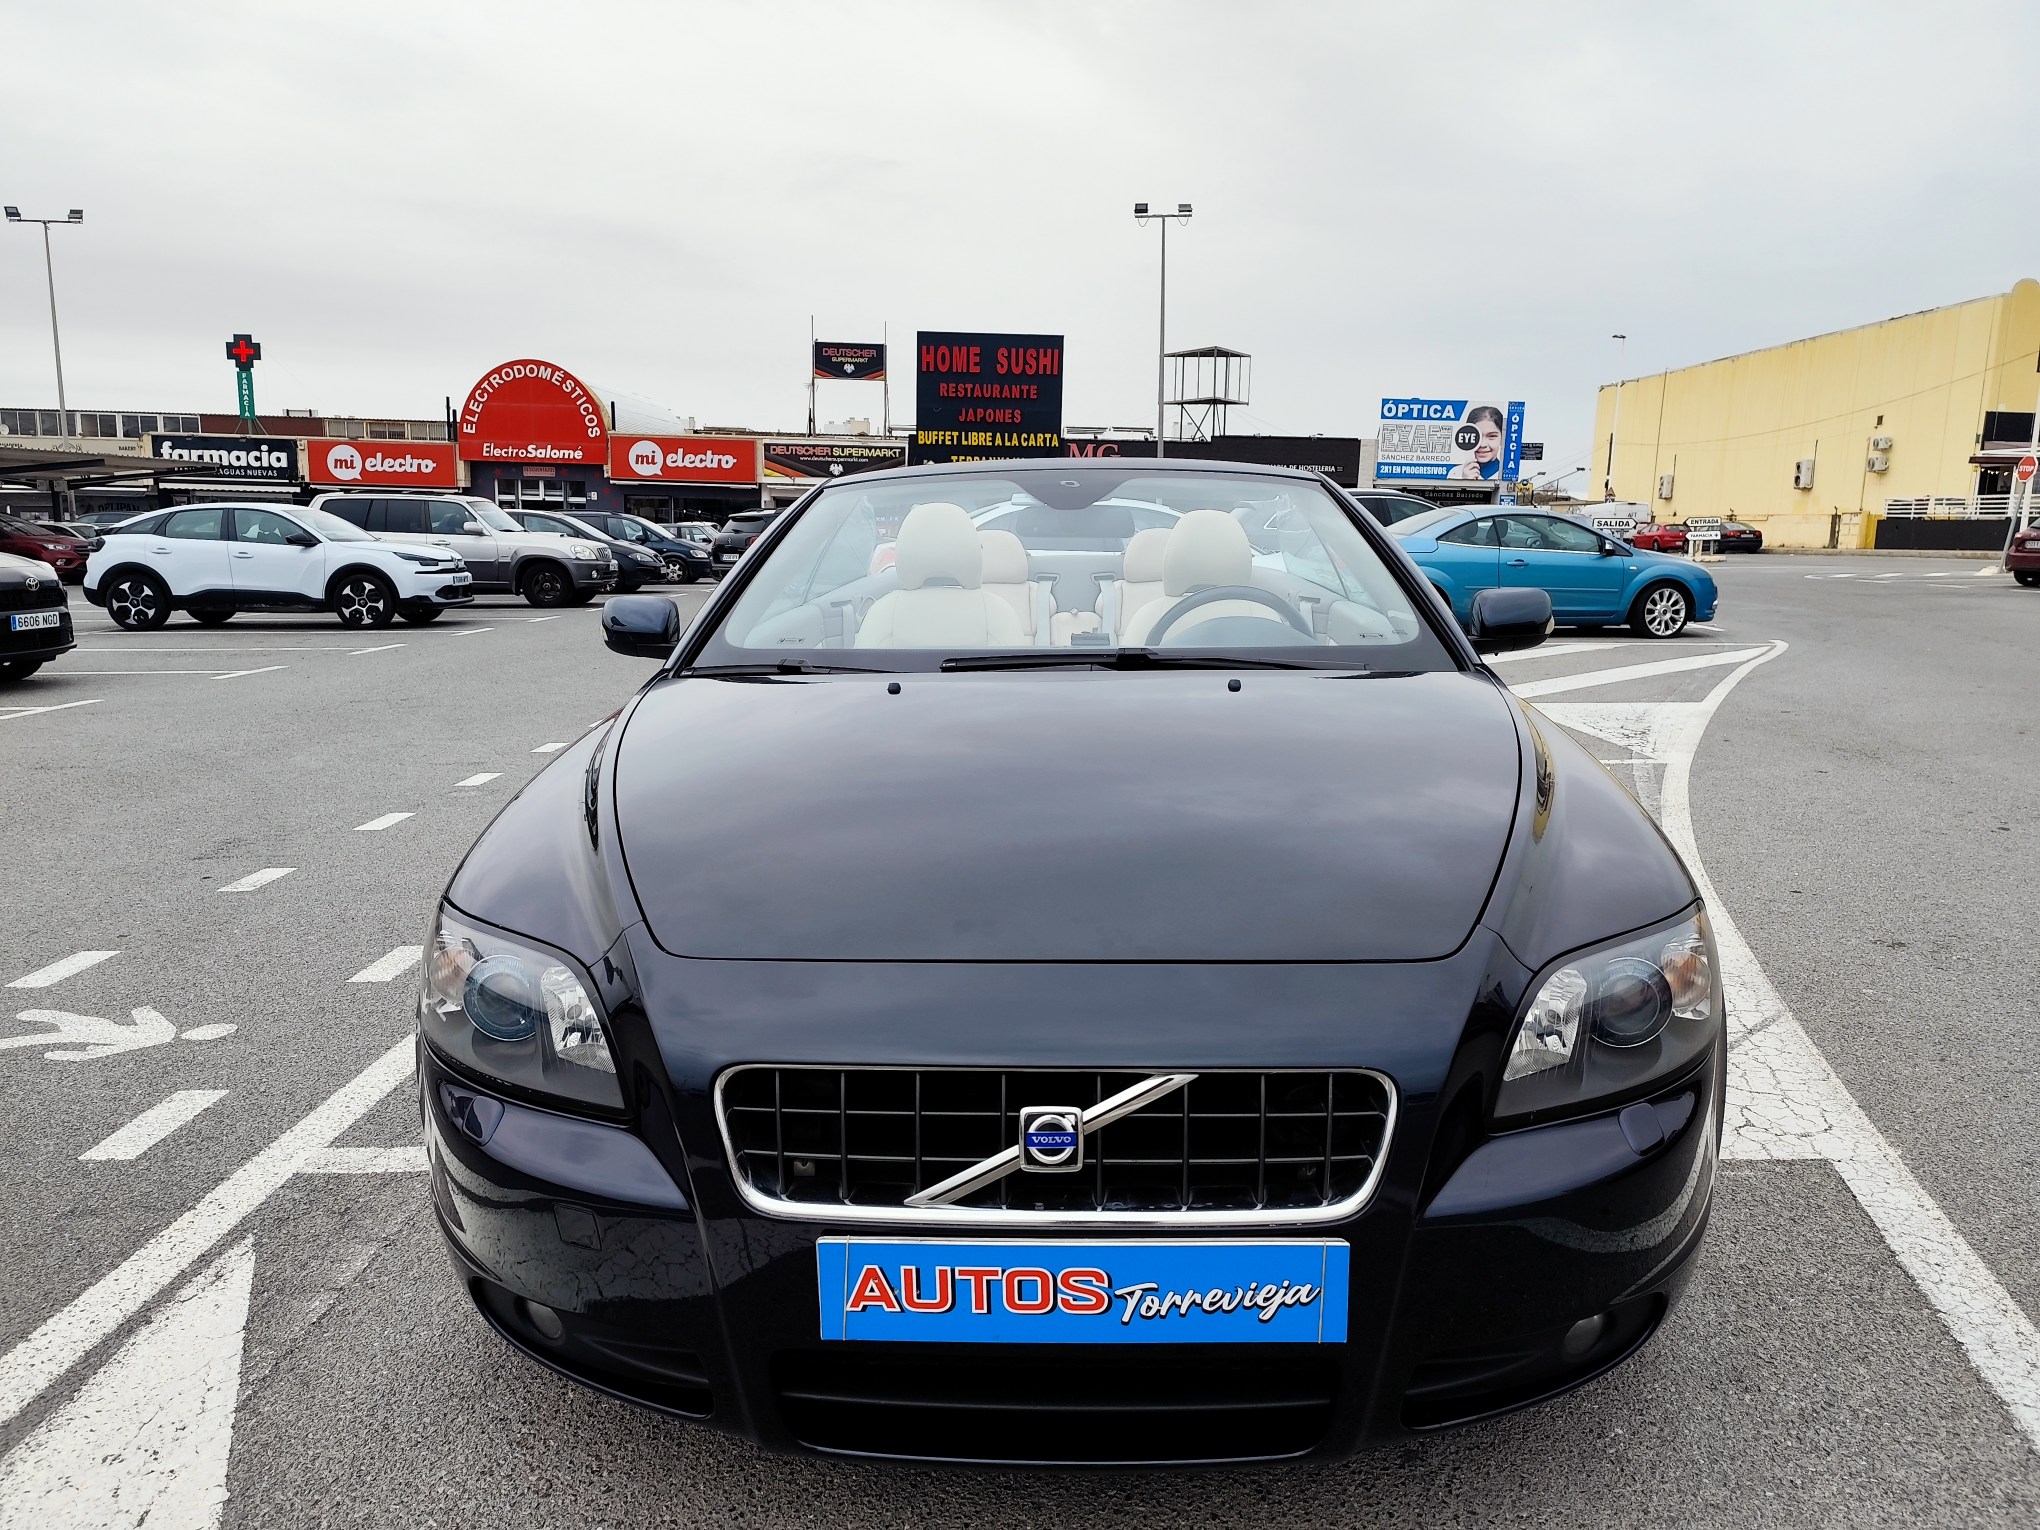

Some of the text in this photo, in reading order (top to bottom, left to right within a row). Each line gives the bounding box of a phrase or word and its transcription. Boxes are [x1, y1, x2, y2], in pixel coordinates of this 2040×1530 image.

[822, 347, 877, 357] DEUTSCHER
[921, 345, 1059, 375] HOME SUSHI
[241, 372, 250, 417] FARMACIA
[940, 383, 1038, 399] RESTAURANTE
[463, 364, 600, 438] ELECTRODOMÉSTICOS
[958, 408, 1022, 423] JAPONES
[1383, 400, 1455, 419] ÓPTICA
[918, 430, 1059, 447] BUFFET LIBRE A LA CARTA
[1458, 433, 1476, 443] EYE
[160, 440, 288, 468] farmacia
[482, 442, 584, 459] ElectroSalomé
[770, 445, 902, 457] DEUTSCHER SUPERMARKT
[1067, 443, 1121, 458] MG
[1381, 453, 1414, 461] SÁNCHEZ
[334, 452, 436, 473] mi electro
[635, 448, 737, 469] mi electro
[218, 468, 278, 477] AGUAS NUEVAS
[1380, 465, 1392, 473] 2X1
[1402, 466, 1447, 475] PROGRESIVOS
[1596, 520, 1630, 528] SALIDA
[17, 613, 58, 628] 6606 NGD
[1031, 1136, 1072, 1144] VOLVO
[846, 1264, 1322, 1324] AUTOS Torrevieja
